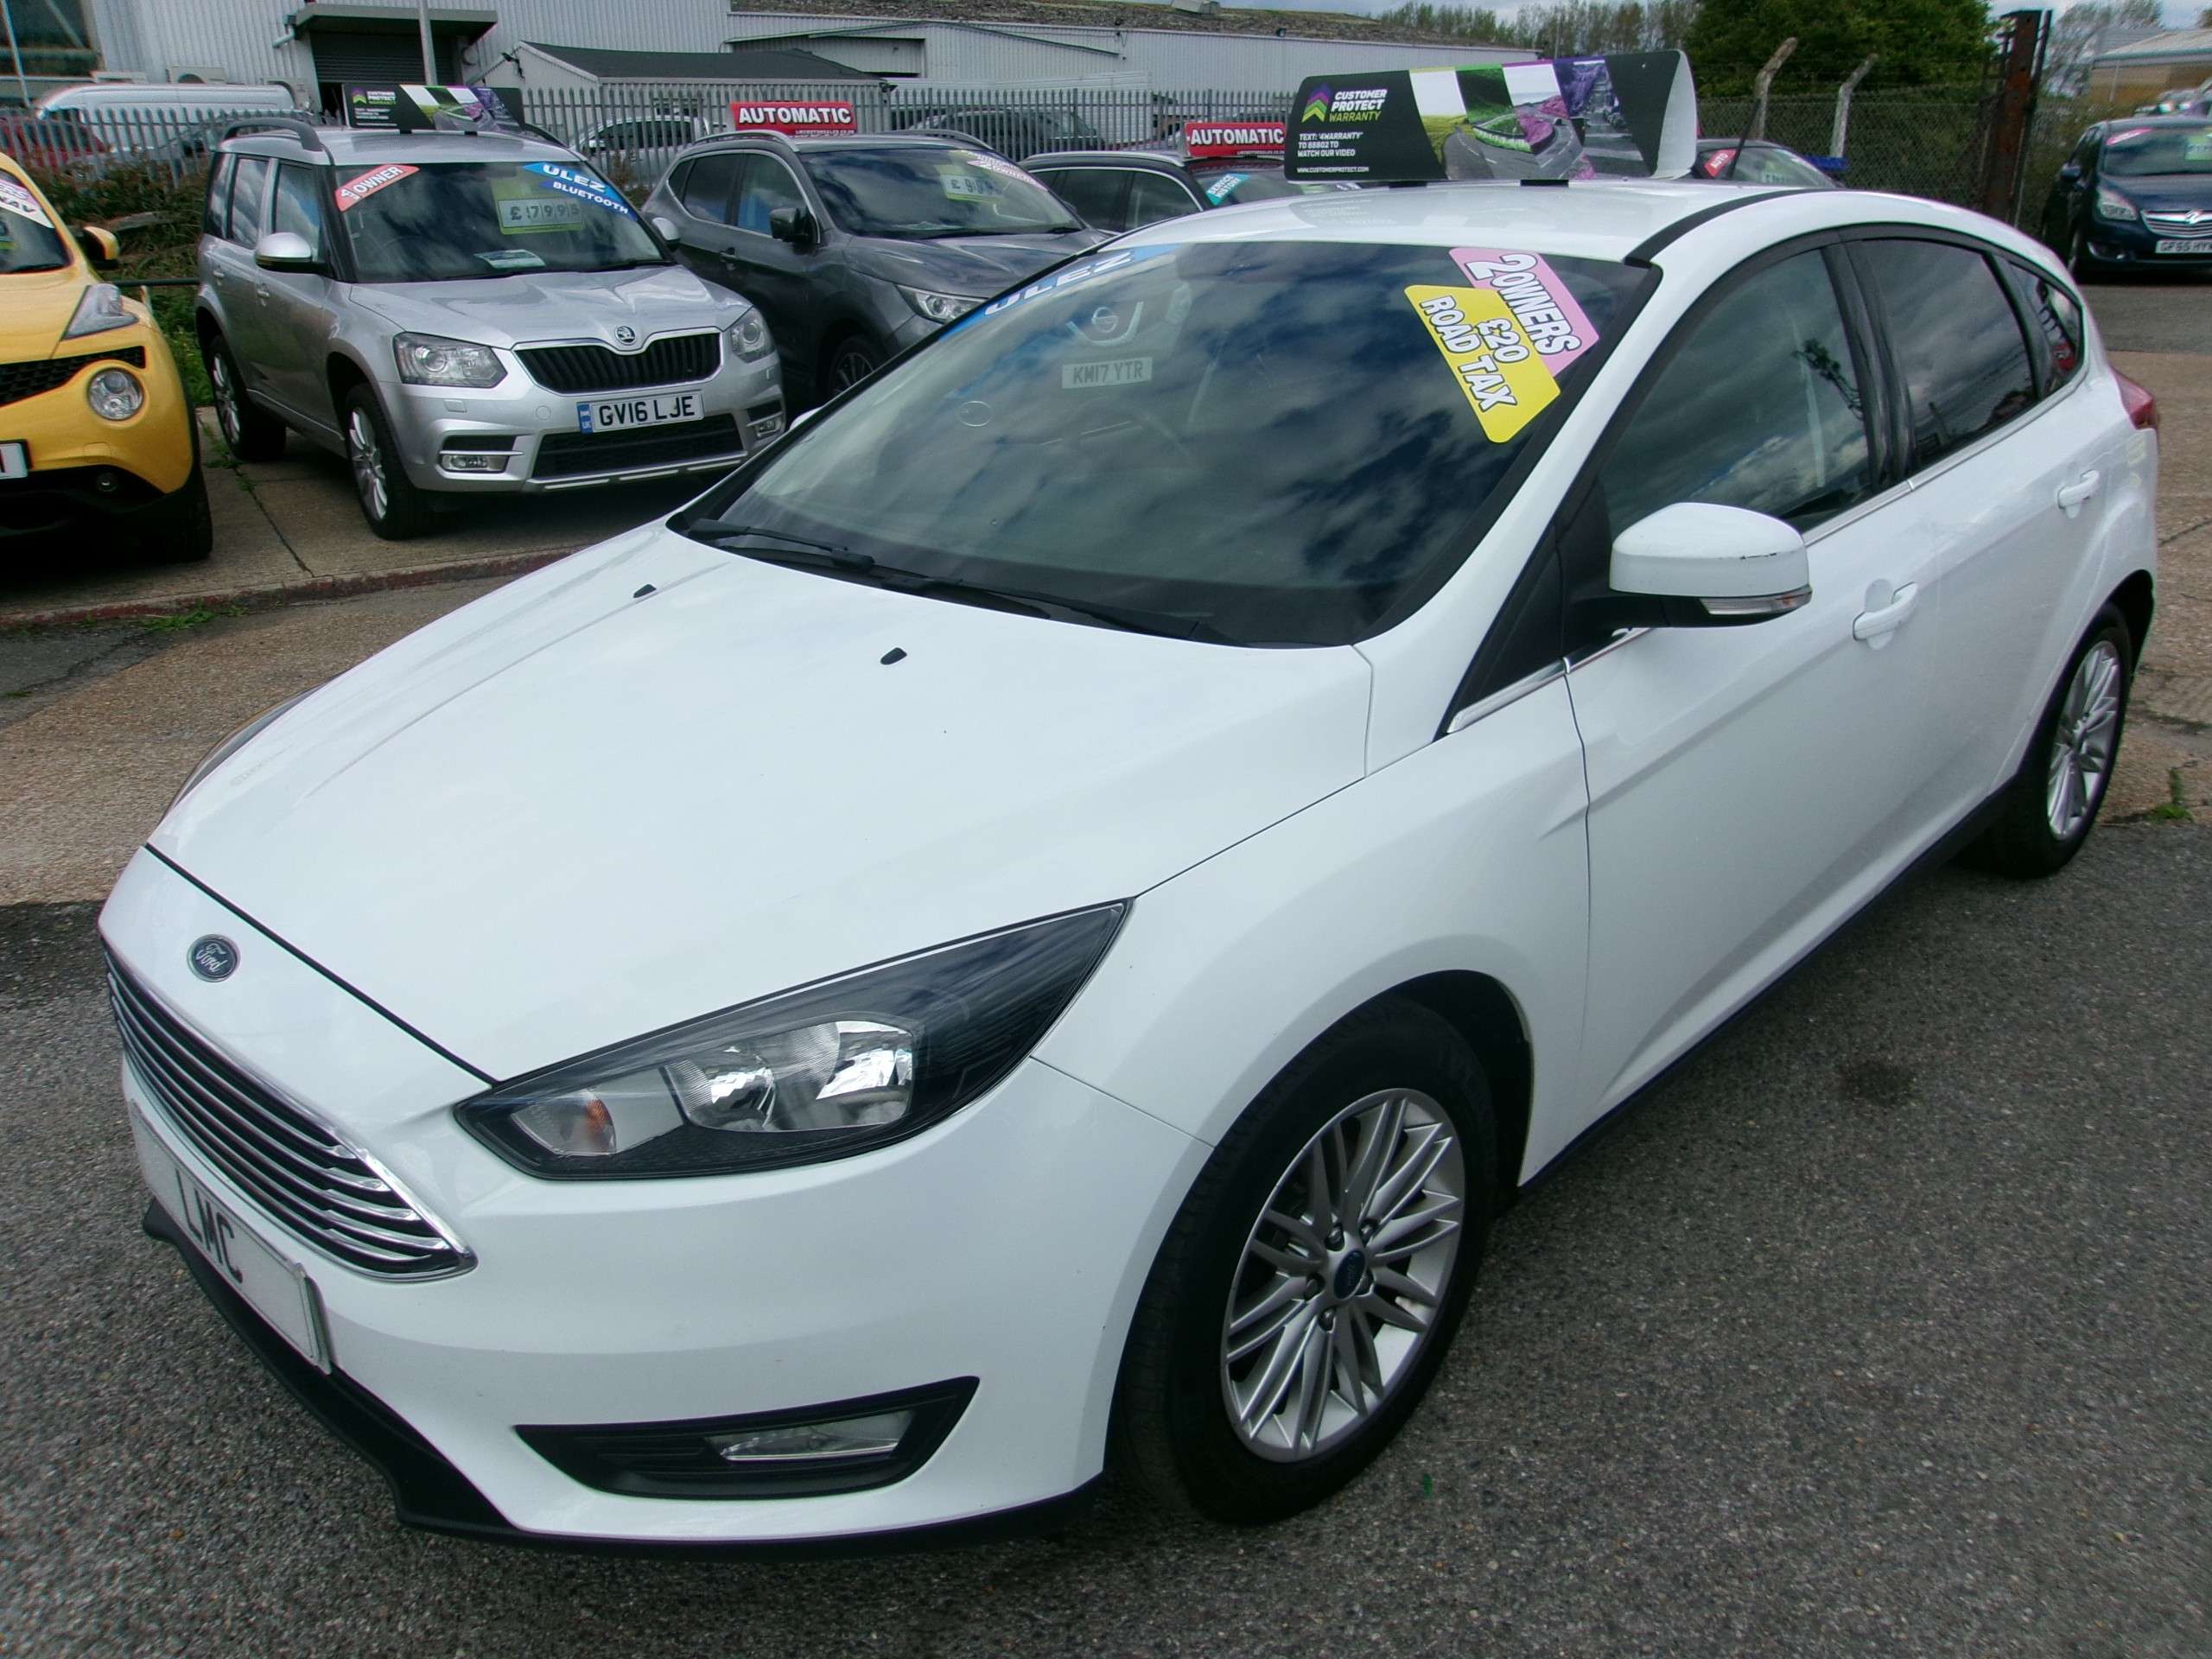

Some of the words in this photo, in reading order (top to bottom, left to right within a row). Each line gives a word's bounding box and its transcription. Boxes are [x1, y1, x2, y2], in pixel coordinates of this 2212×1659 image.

[1332, 99, 1385, 112] PROTECT
[1335, 89, 1388, 100] CUSTOMER
[739, 107, 852, 124] AUTOMATIC
[1329, 111, 1382, 122] WARRANTY
[1191, 129, 1284, 145] AUTOMATIC
[1299, 133, 1318, 142] TEXT:
[1709, 153, 1729, 169] AUTO
[353, 166, 404, 194] OWNER
[543, 164, 606, 194] ULEZ
[553, 181, 628, 214] BLUETOOTH
[1465, 253, 1537, 281] 2
[1490, 272, 1583, 355] OWNERS
[1420, 295, 1482, 353] ROAD
[1458, 354, 1518, 413] TAX
[1474, 318, 1530, 364] £20
[1113, 359, 1143, 380] YTR
[599, 401, 648, 427] GV16
[653, 396, 695, 420] LJE
[195, 943, 228, 972] Ford
